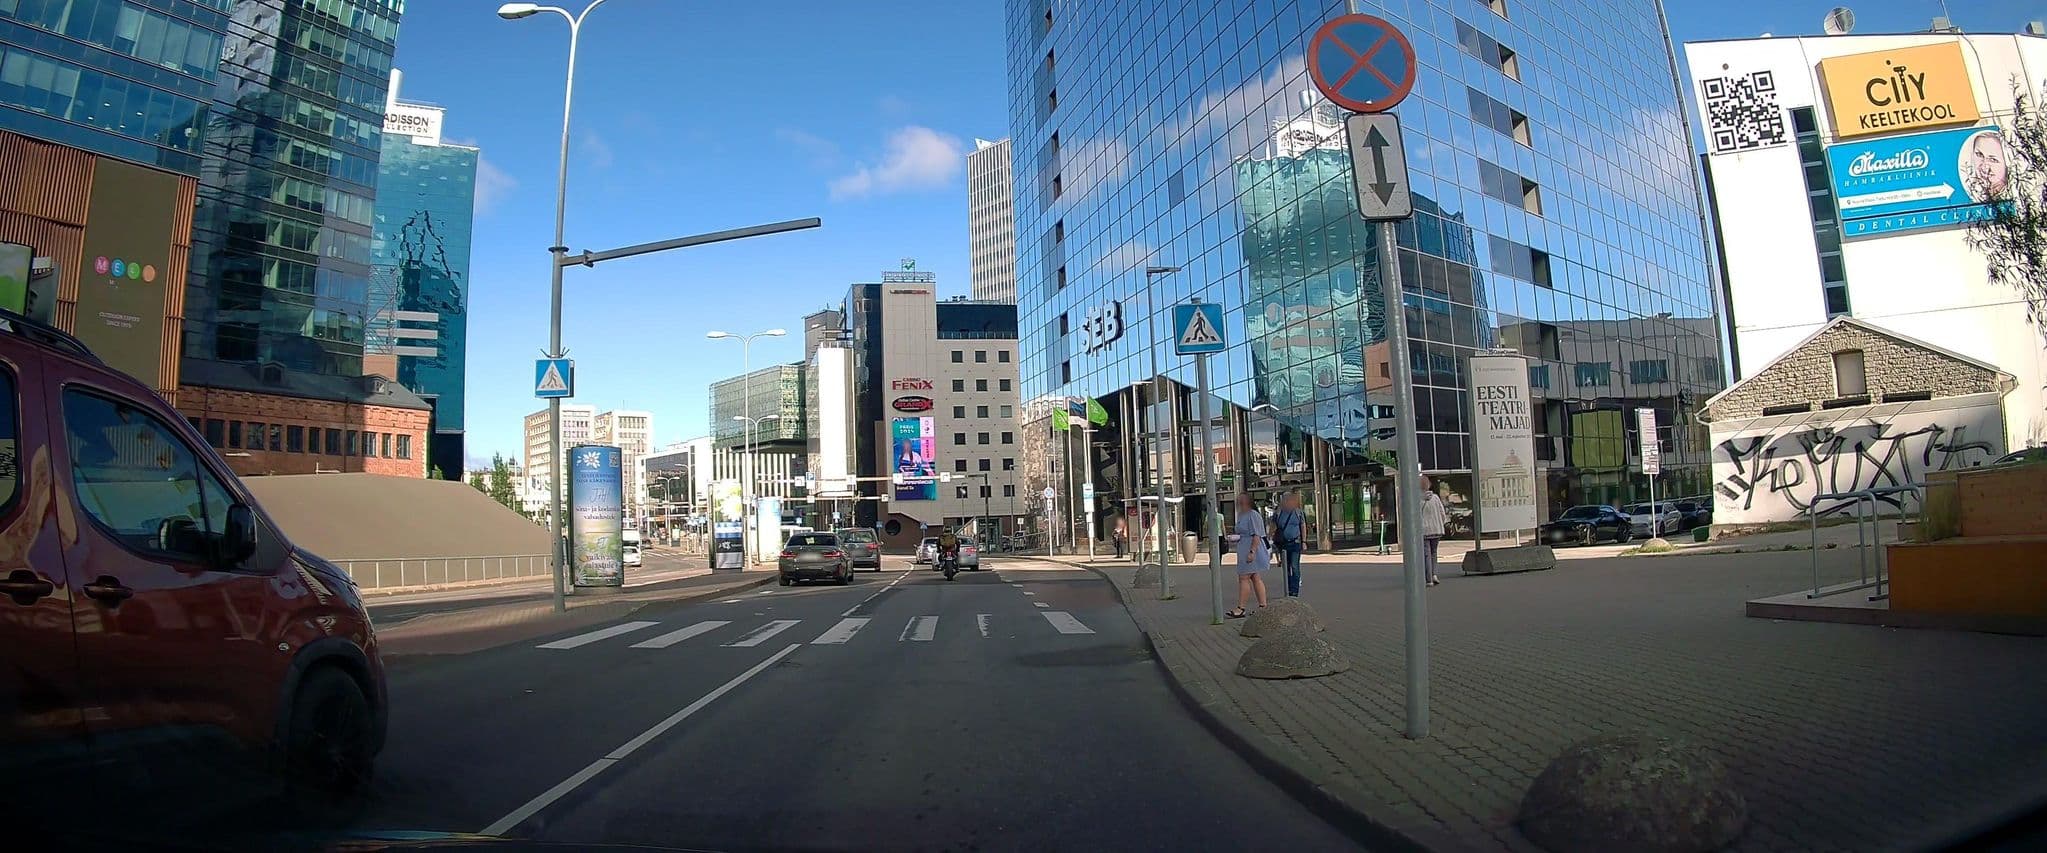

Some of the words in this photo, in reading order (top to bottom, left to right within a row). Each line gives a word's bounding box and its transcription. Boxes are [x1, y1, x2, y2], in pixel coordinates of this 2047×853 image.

[1866, 66, 1925, 107] CITY
[383, 113, 429, 127] ADISSON
[1859, 103, 1956, 129] KEELTEKOOL
[1849, 148, 1929, 177] Maxilla
[1844, 169, 1936, 187] HAMBAKLIINIK
[1858, 215, 1929, 231] DENTAL
[1080, 300, 1124, 354] SEB
[1476, 385, 1518, 401] EESTI
[1478, 400, 1529, 415] TEATRI-
[1490, 416, 1531, 430] MAJAD
